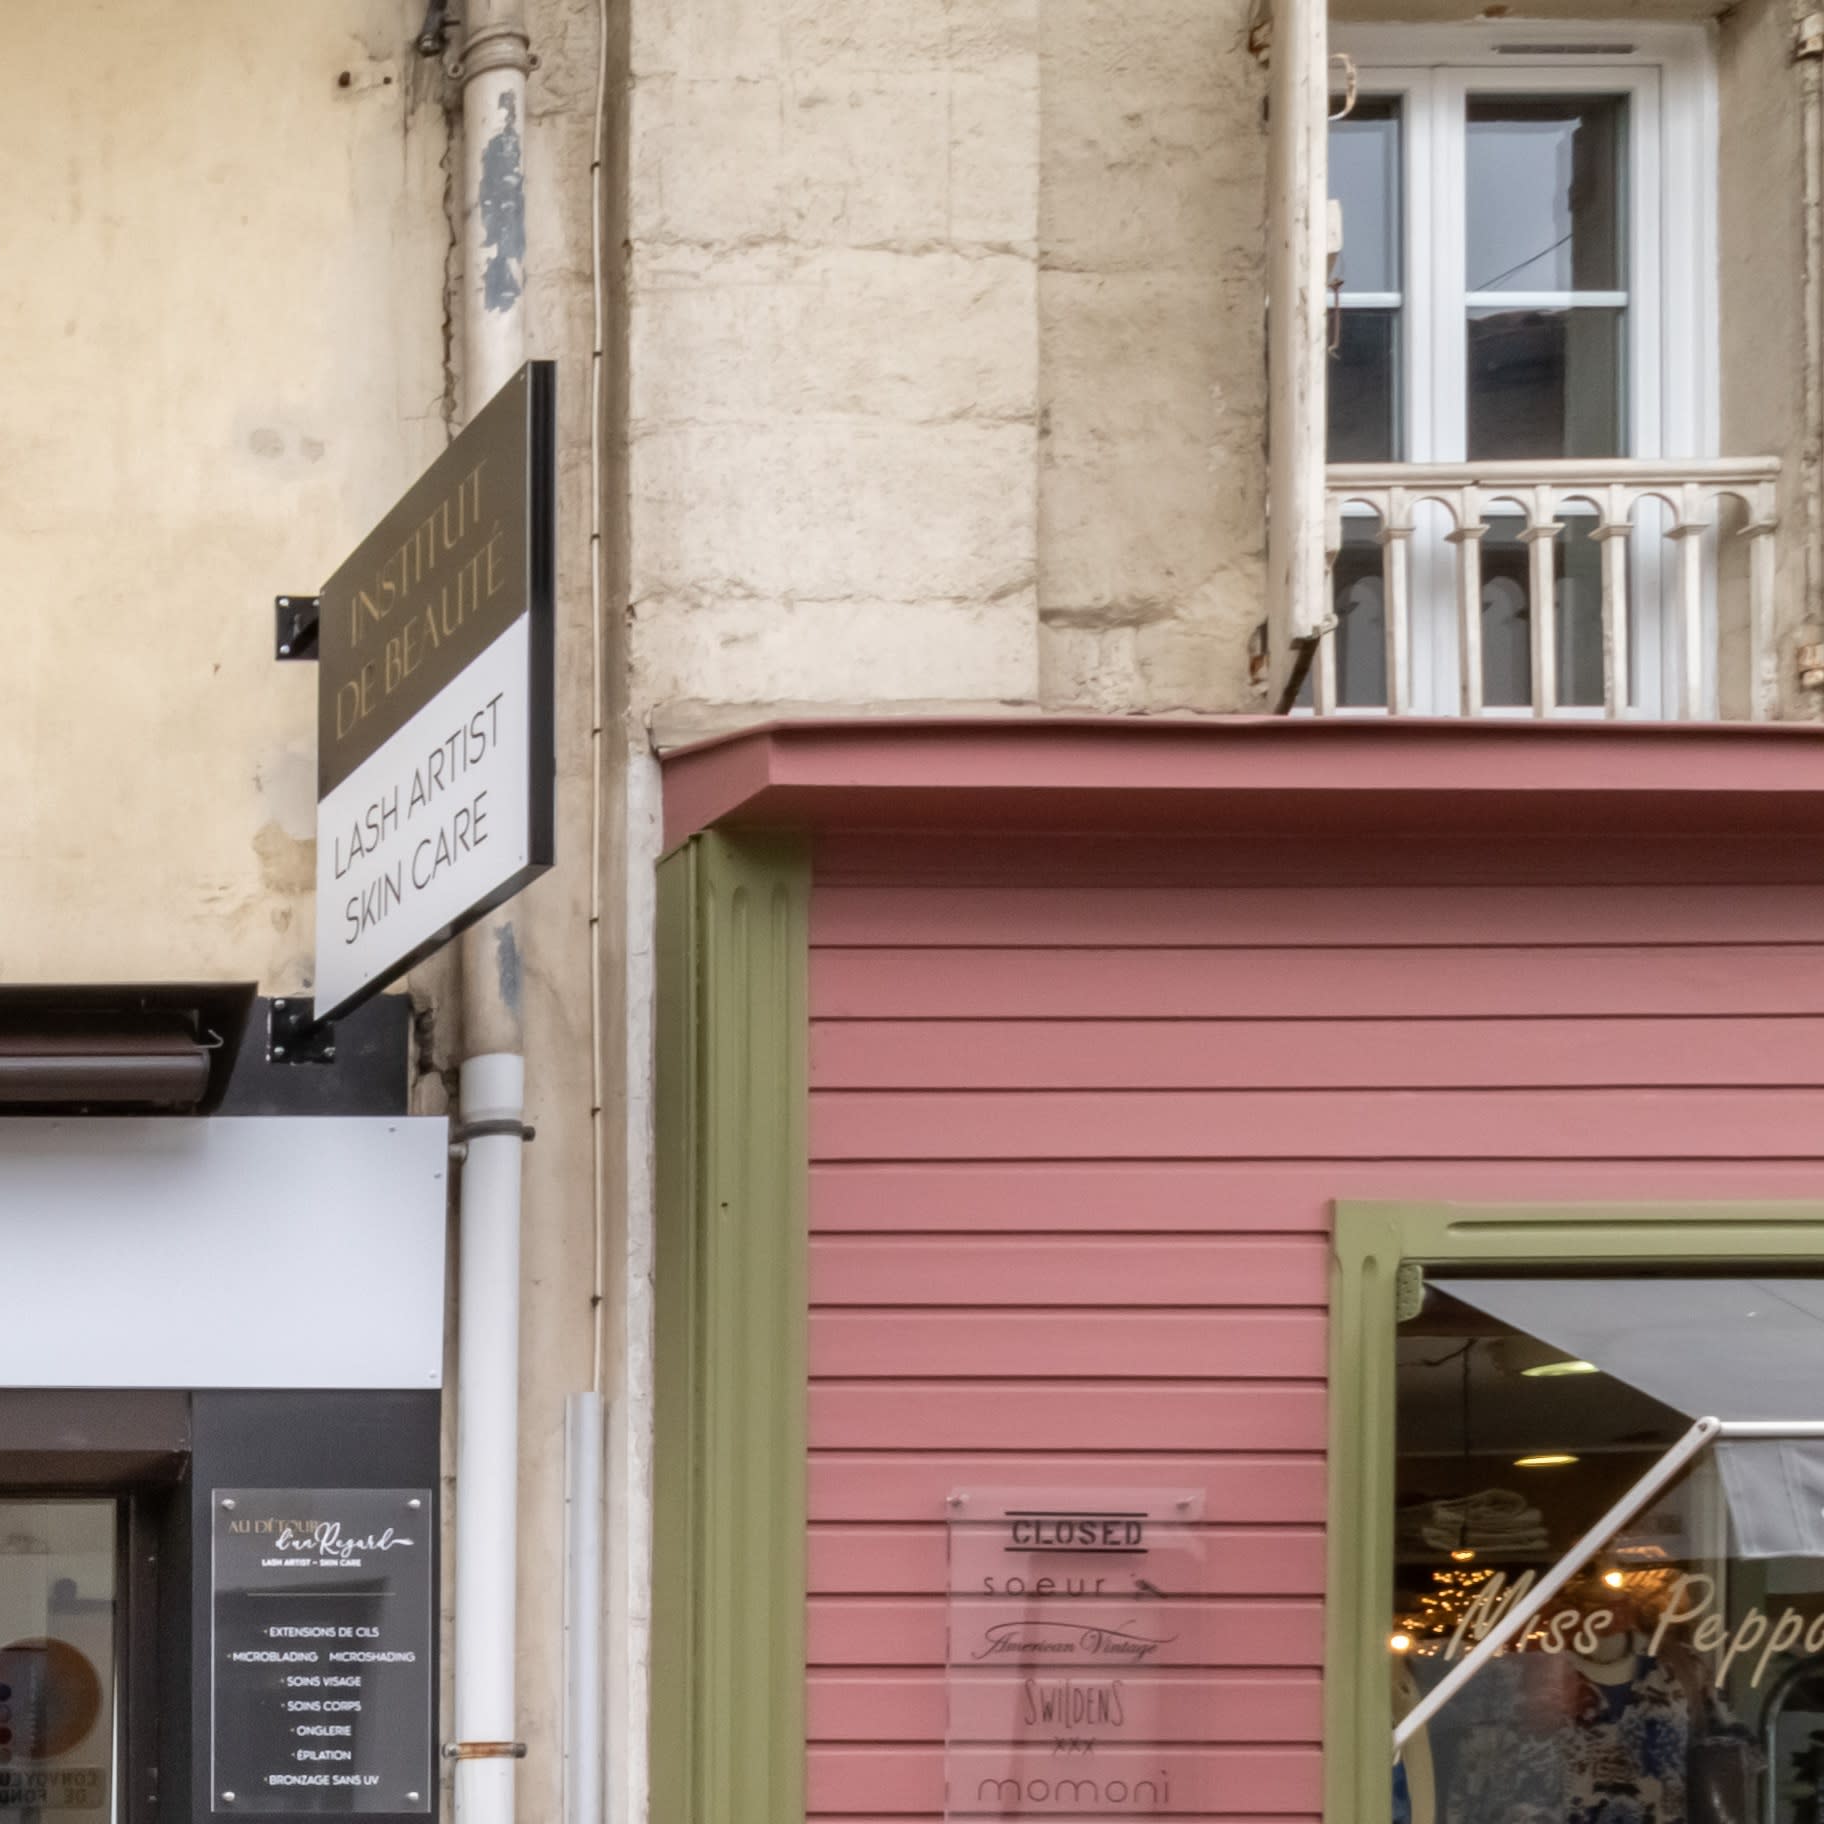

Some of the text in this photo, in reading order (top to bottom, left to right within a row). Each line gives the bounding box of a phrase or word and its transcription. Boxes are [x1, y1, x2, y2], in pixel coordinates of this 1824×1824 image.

[351, 458, 488, 649] INSTITUT
[336, 519, 505, 741] DE BEAUTÉ
[335, 692, 504, 880] LASH ARTIST
[345, 790, 488, 944] SKIN CARE
[228, 1519, 250, 1534] AU
[314, 1521, 398, 1558] Regard
[1011, 1519, 1143, 1546] CLOSED
[261, 1558, 283, 1567] LASH
[283, 1558, 311, 1567] ARTIST
[340, 1558, 362, 1567] CARE
[983, 1577, 1105, 1597] soeur
[1443, 1569, 1614, 1662] Miss
[269, 1626, 380, 1638] EXTENSIONS DE CILS
[971, 1622, 1161, 1663] American Vintage
[232, 1651, 416, 1662] MICROBLADING MICROSHADING
[286, 1676, 362, 1687] SOINS VISAGE
[287, 1701, 362, 1712] SOINS CORPS
[296, 1725, 352, 1737] ONGLERIE
[296, 1748, 352, 1761] ÉPILATION
[269, 1774, 380, 1786] BRONZAGE SANS UV
[978, 1769, 1169, 1804] momoni
